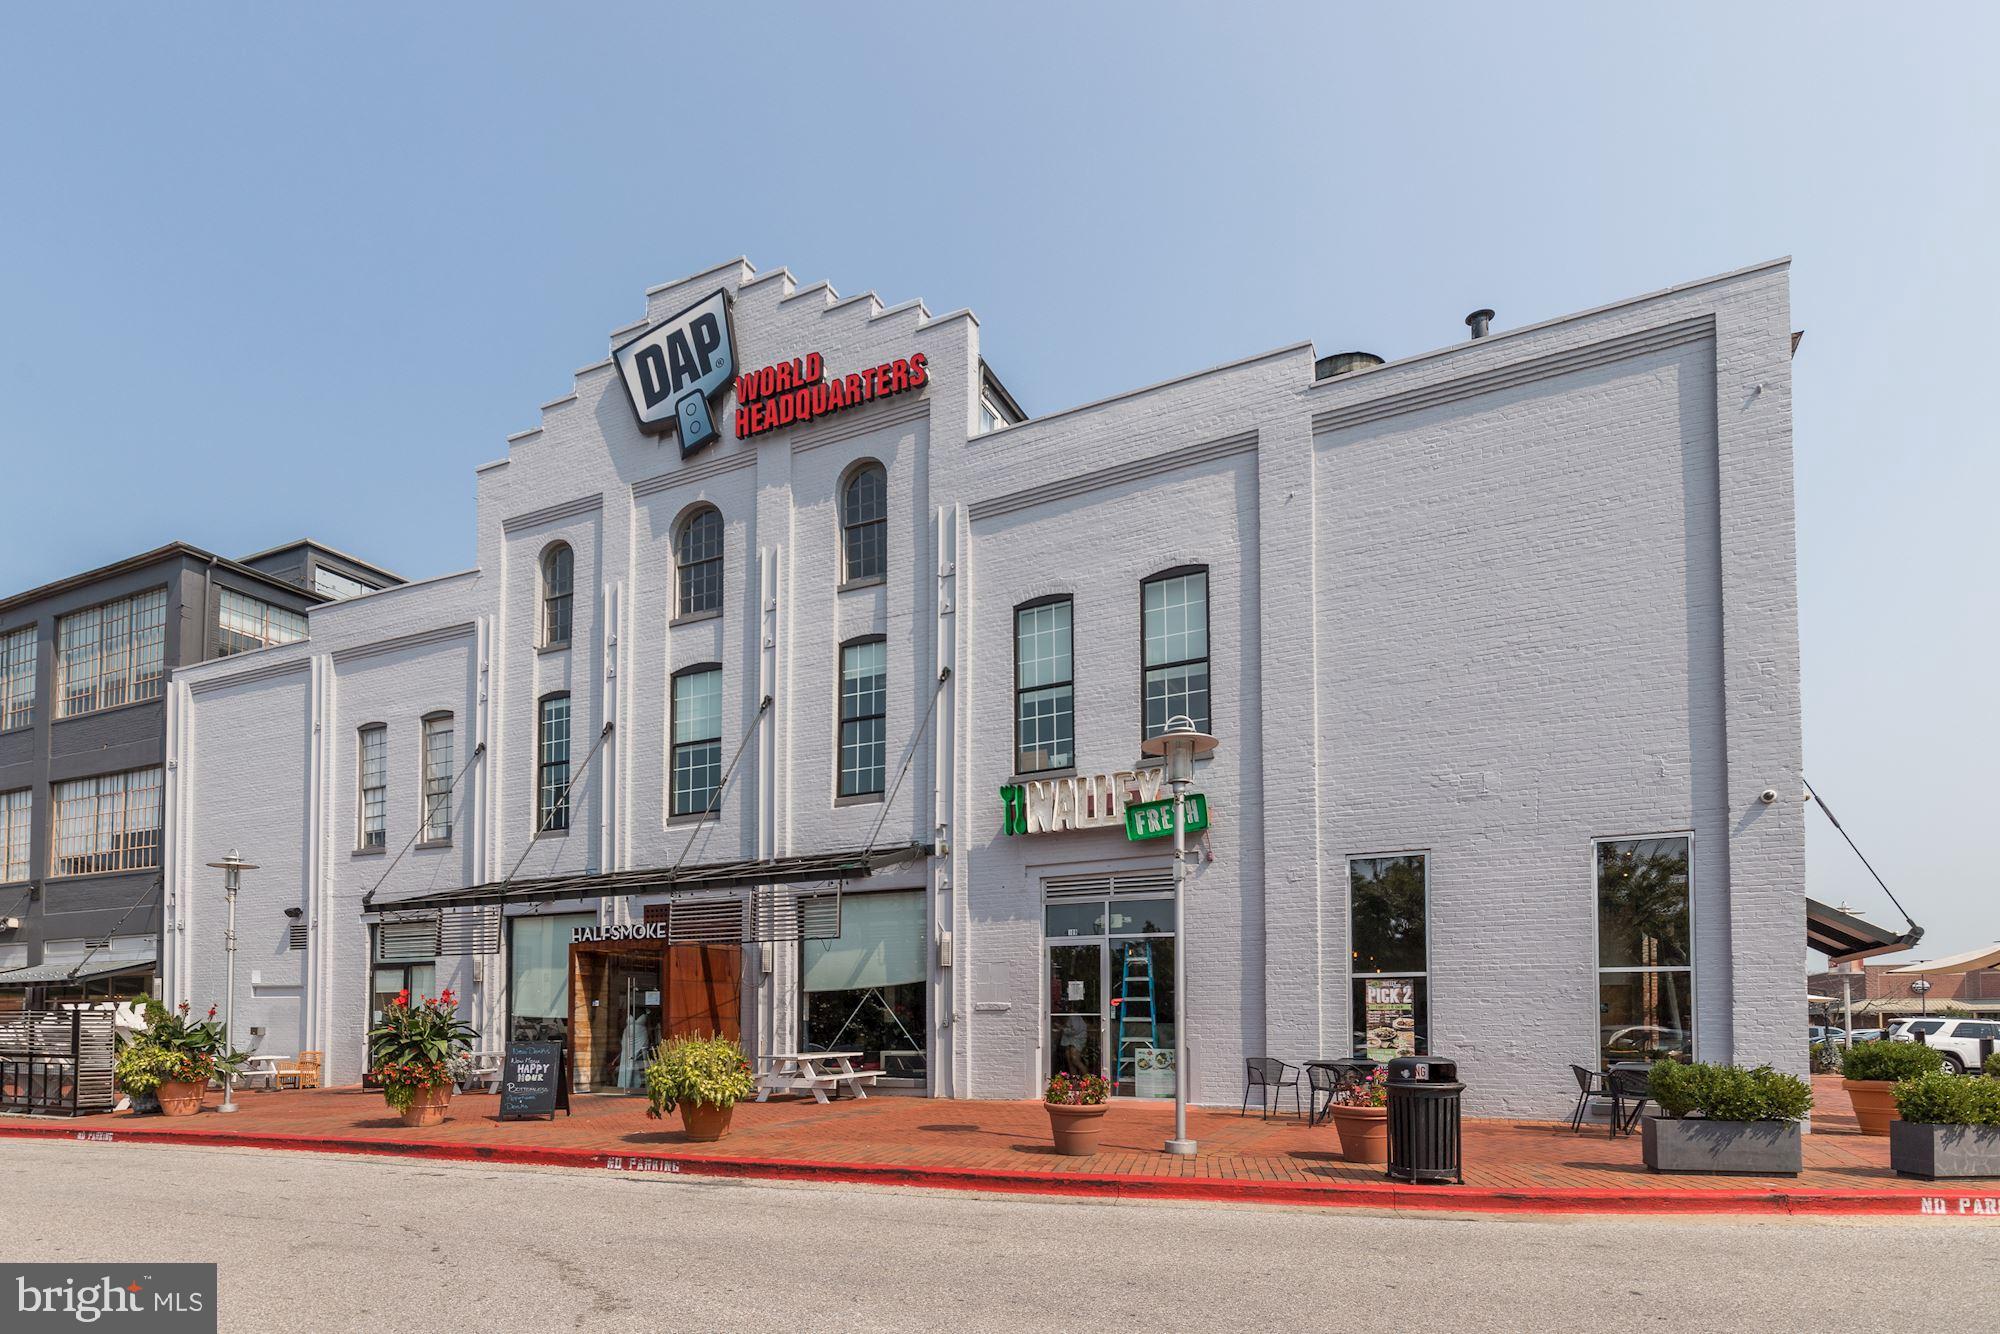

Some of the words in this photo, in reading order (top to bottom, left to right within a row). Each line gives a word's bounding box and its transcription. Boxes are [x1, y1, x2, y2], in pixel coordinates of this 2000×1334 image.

[634, 312, 721, 410] DAP
[736, 351, 824, 406] WORLD
[735, 352, 929, 440] HEADQUARTERS
[1026, 768, 1164, 834] NALLEY
[1134, 799, 1200, 836] FREH
[571, 922, 667, 943] HALFSMOKE
[1367, 986, 1400, 1004] PICK
[1402, 985, 1413, 1004] 2
[517, 1064, 550, 1074] HAPPY
[517, 1074, 544, 1082] HOUR
[606, 1157, 622, 1170] NO
[628, 1157, 680, 1173] PARKING
[1921, 1197, 1947, 1214] NO
[1959, 1198, 2000, 1215] PAR
